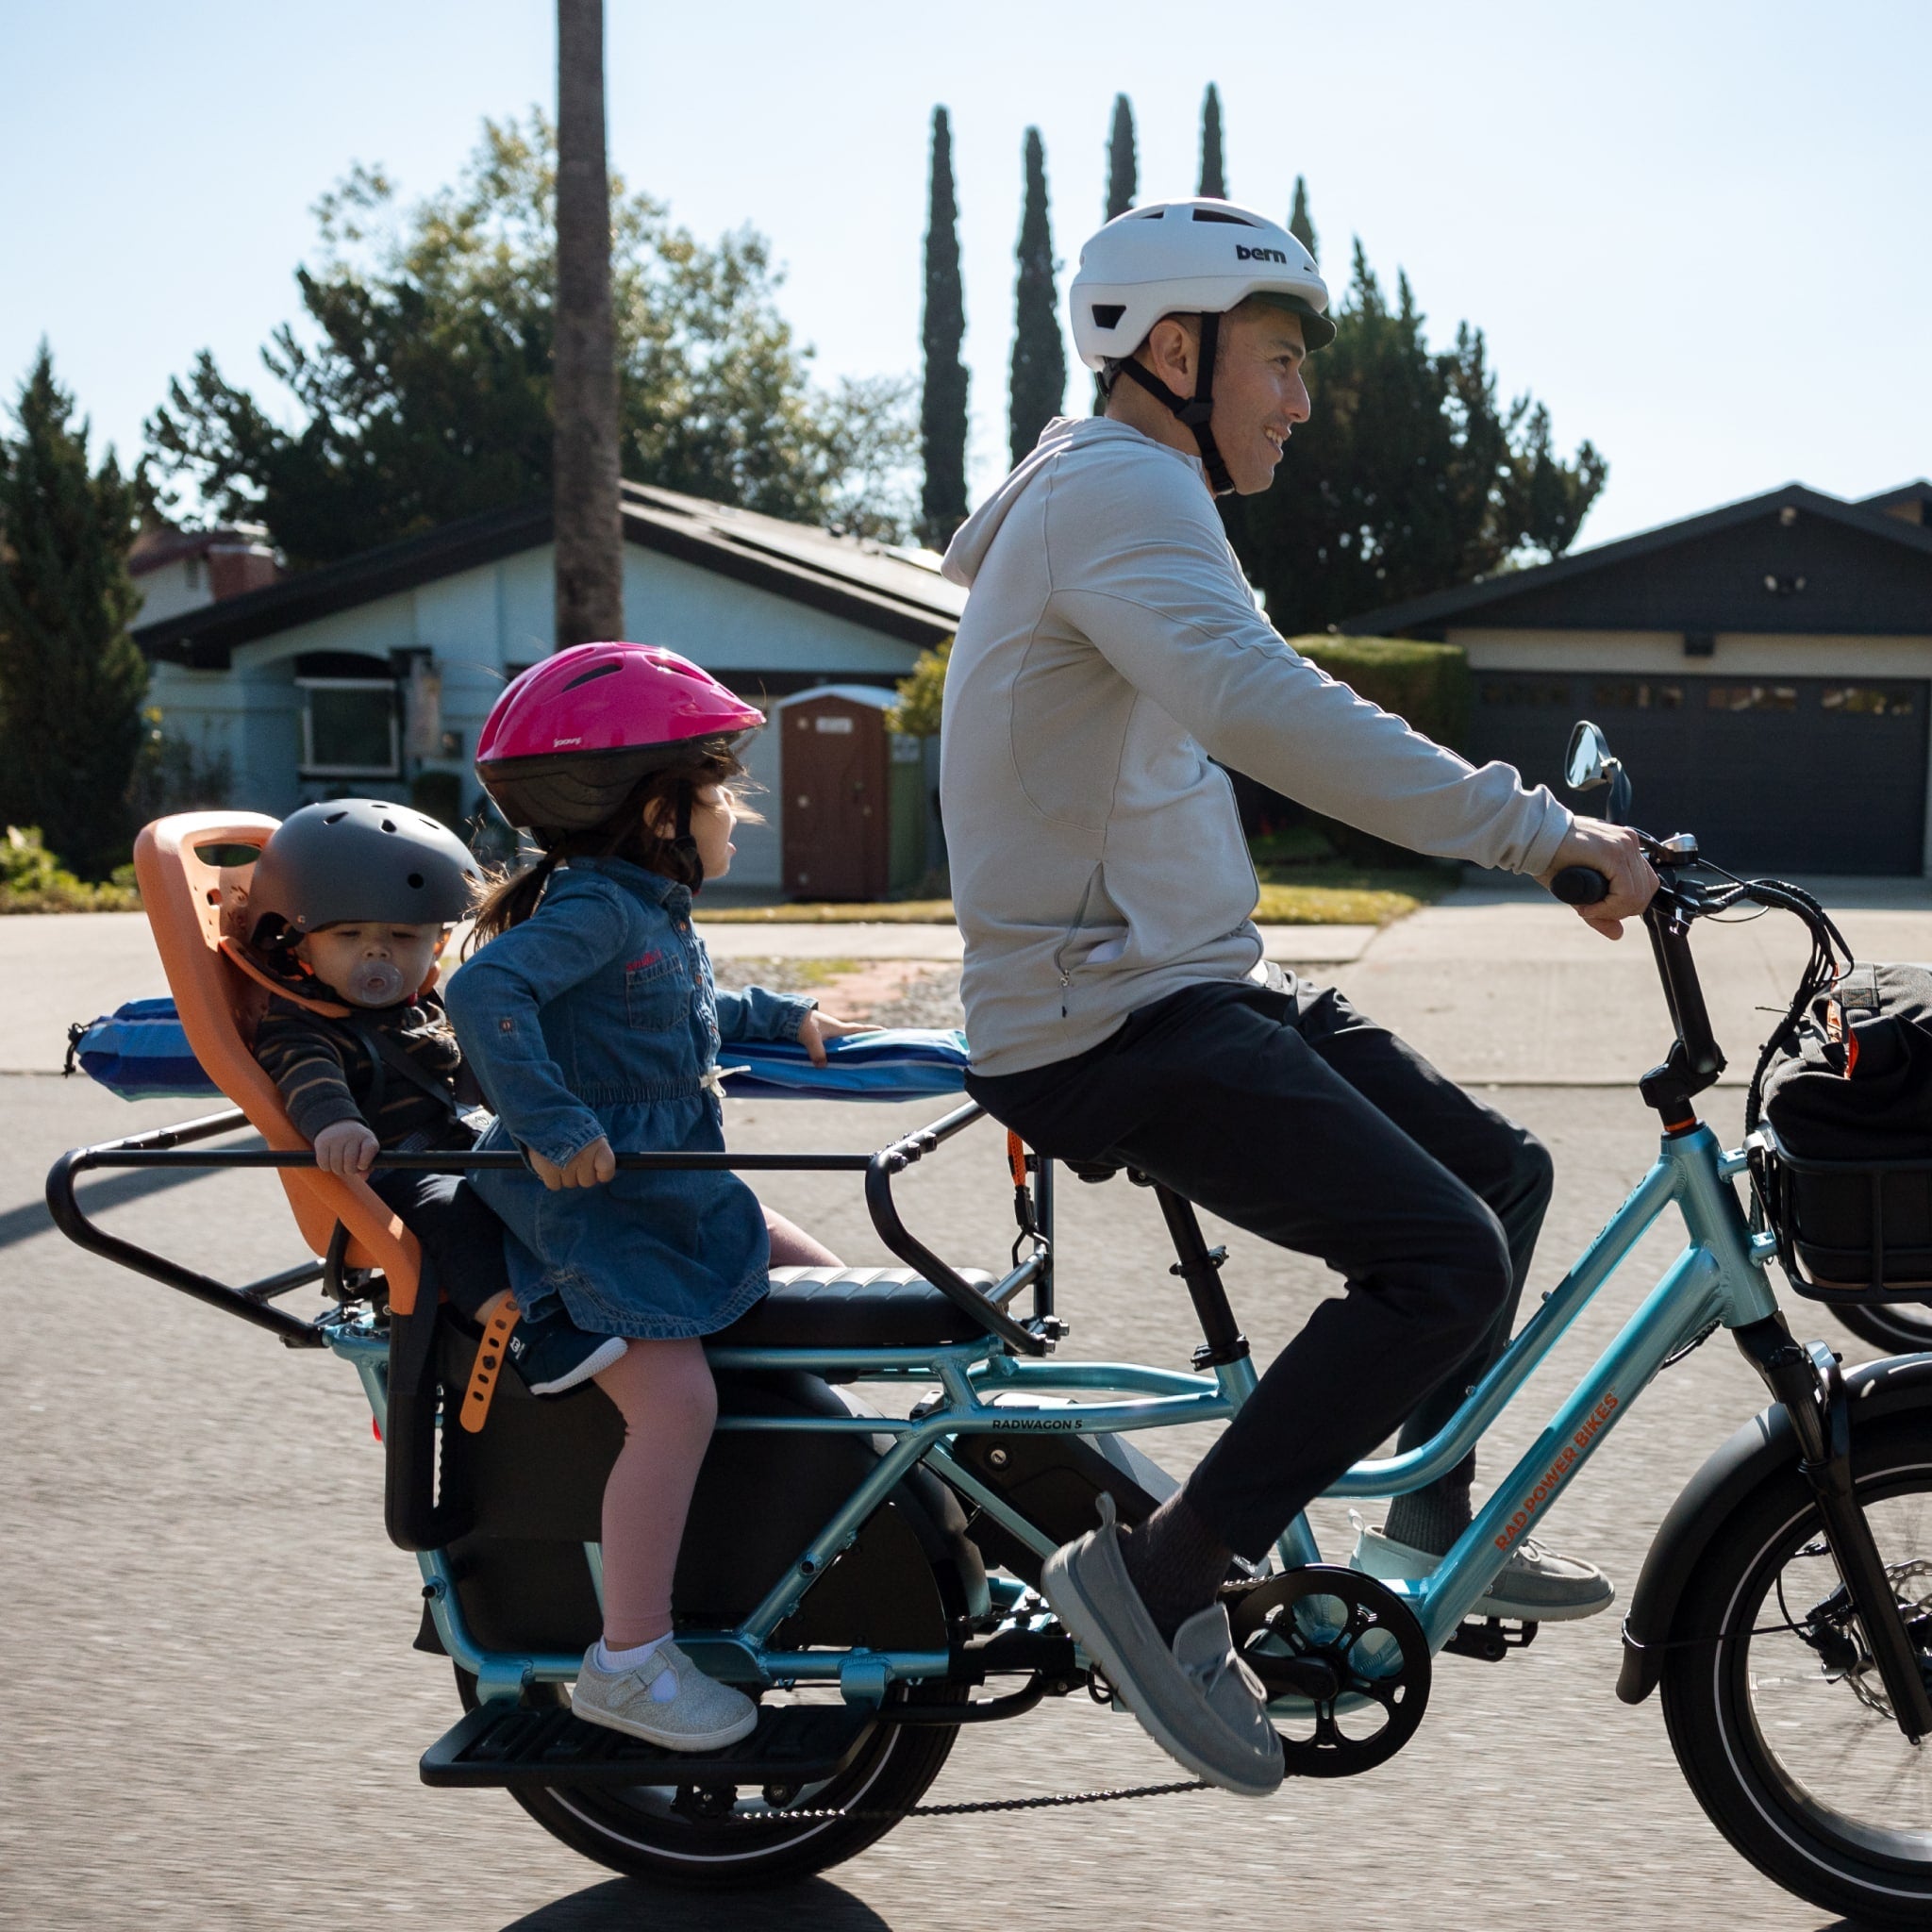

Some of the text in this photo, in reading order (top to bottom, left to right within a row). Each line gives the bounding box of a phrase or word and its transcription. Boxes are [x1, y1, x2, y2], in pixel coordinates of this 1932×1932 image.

[1236, 244, 1287, 264] bern
[992, 1420, 1083, 1430] RADWAGON 5
[1494, 1392, 1619, 1551] RAD POWER BIKES
